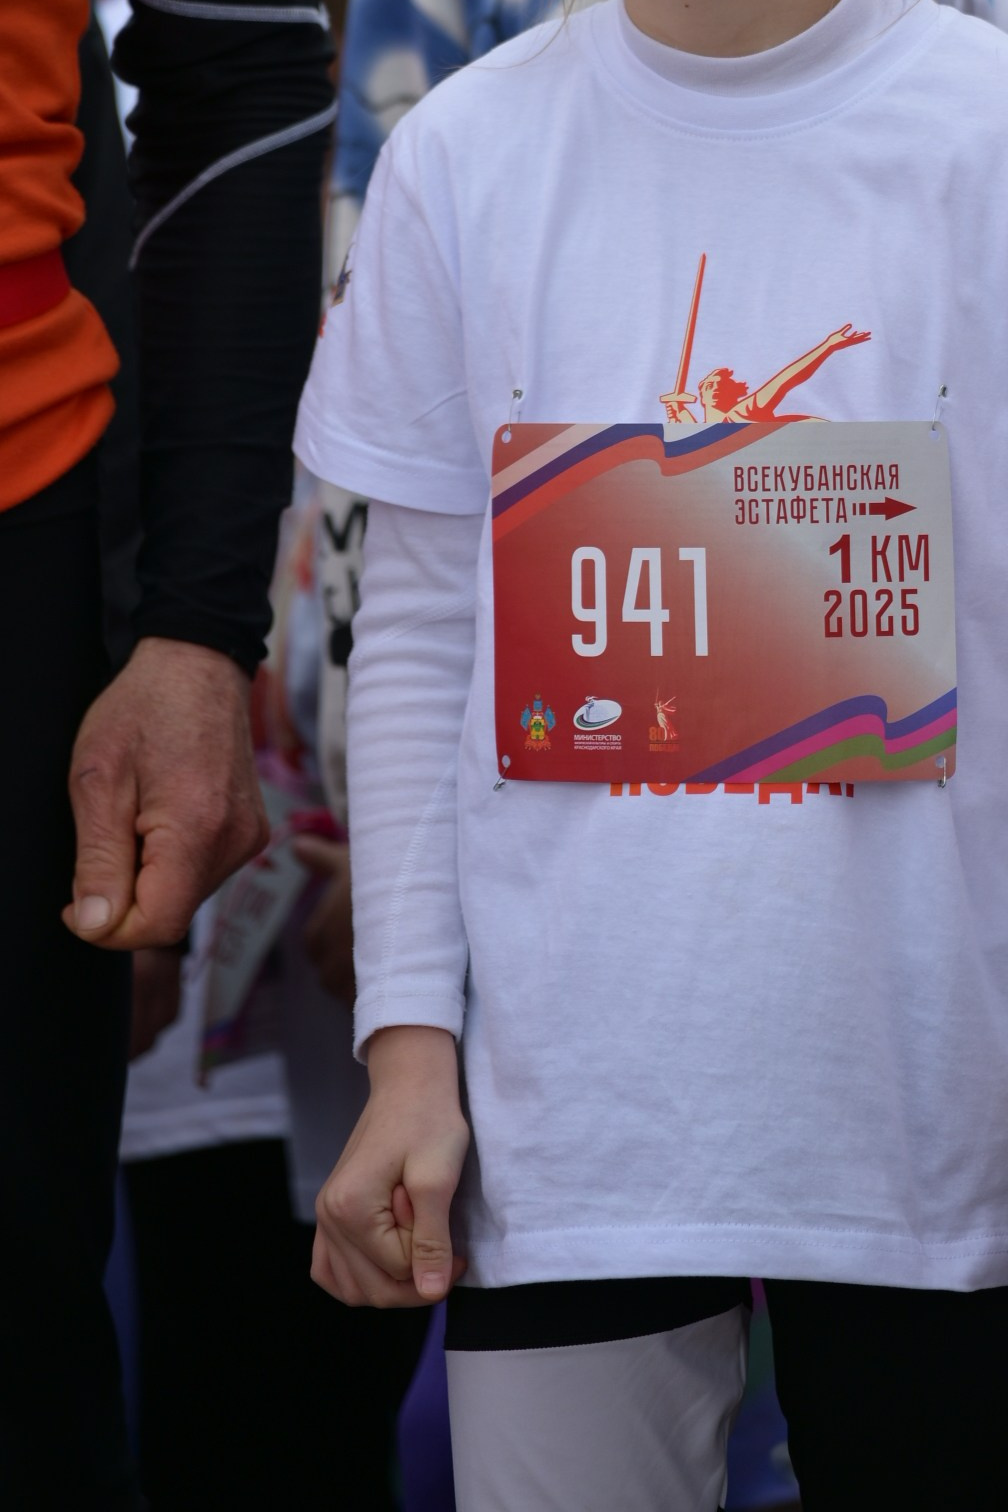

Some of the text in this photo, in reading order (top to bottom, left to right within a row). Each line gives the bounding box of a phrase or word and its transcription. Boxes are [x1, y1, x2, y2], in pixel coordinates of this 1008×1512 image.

[734, 464, 899, 492] ВСЕКУБАНСКАЯ
[734, 497, 847, 525] ЭСТАФЕТА
[829, 534, 930, 583] 1 КМ
[571, 546, 709, 657] 941
[823, 589, 920, 638] 2025
